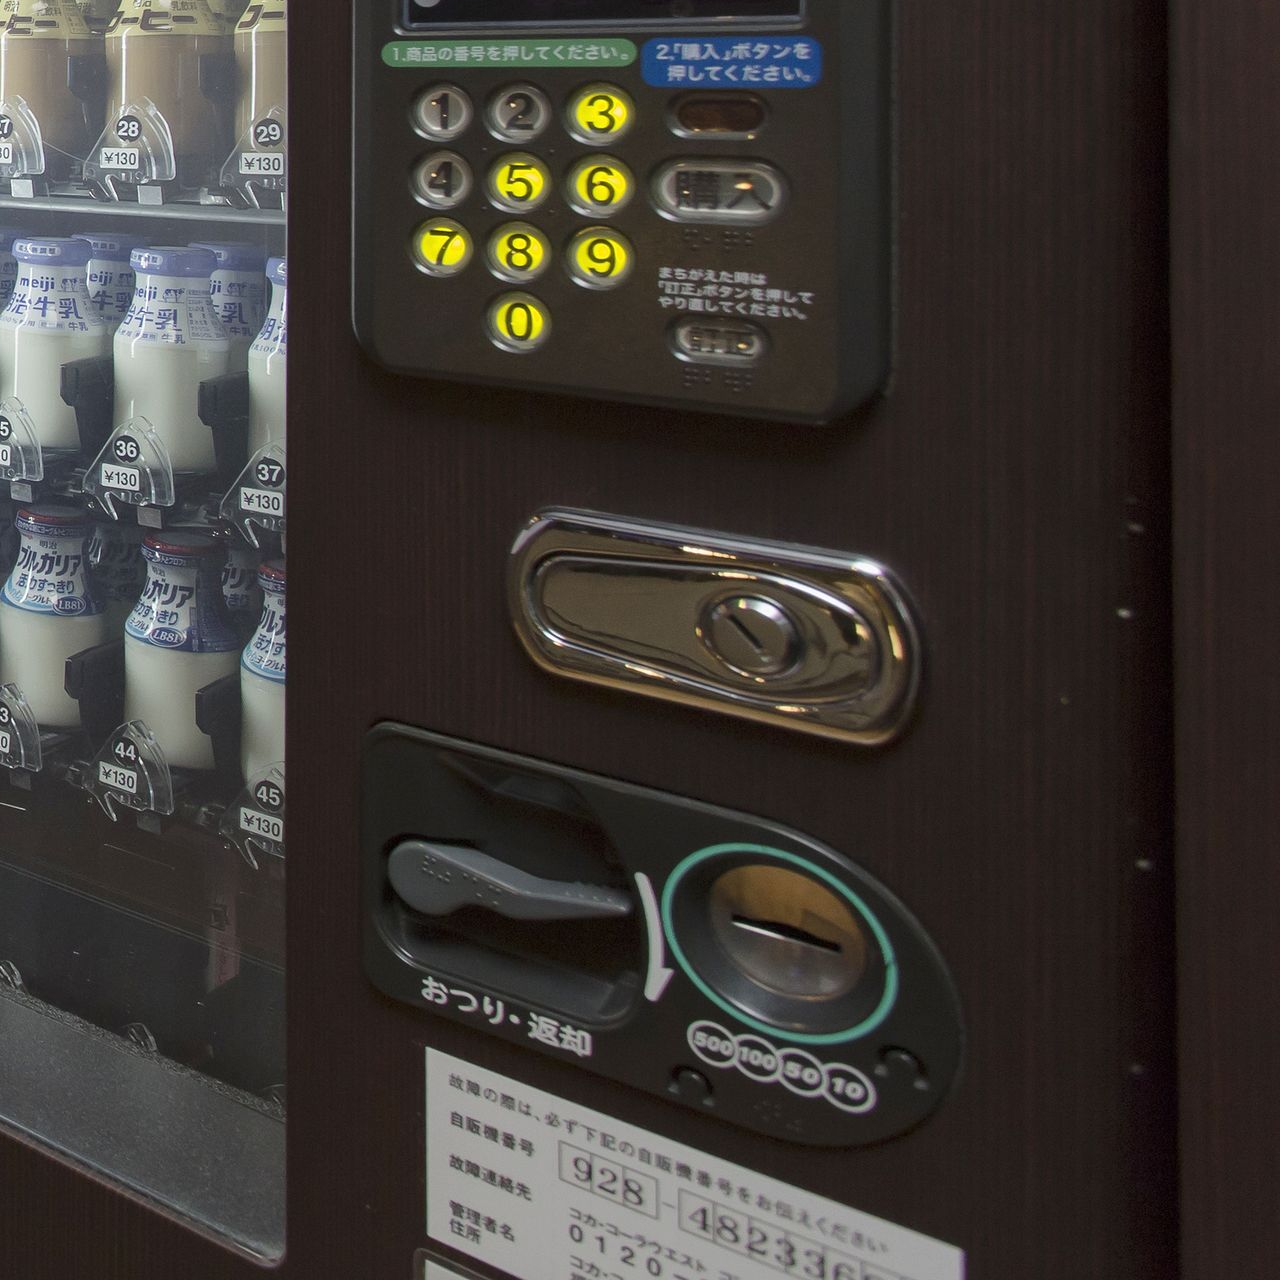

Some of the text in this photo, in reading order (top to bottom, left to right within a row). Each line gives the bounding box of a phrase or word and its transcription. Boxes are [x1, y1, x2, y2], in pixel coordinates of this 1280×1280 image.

[393, 45, 630, 63] 1.商品の番号を押してください。
[667, 64, 813, 82] 押してください。
[505, 98, 535, 132] 2
[585, 94, 616, 134] 3
[117, 121, 139, 137] 28
[256, 124, 281, 142] 29
[103, 149, 138, 166] ¥130
[245, 157, 281, 172] ¥130
[428, 161, 454, 199] 4
[506, 163, 535, 202] 5
[586, 166, 617, 207] 6
[676, 170, 772, 211] 購入
[429, 229, 456, 266] 7
[505, 233, 534, 273] 8
[586, 239, 618, 278] 9
[20, 276, 55, 291] meiji
[658, 267, 767, 286] まちがえた時は
[658, 297, 808, 320] やり直してください。
[505, 303, 534, 342] 0
[116, 440, 137, 458] 36
[105, 470, 138, 487] ¥130
[257, 464, 282, 482] 37
[244, 491, 281, 510] ¥130
[19, 545, 82, 578] ブルガリア
[60, 600, 83, 611] LB81
[154, 631, 180, 644] LB81
[115, 742, 137, 761] 44
[102, 767, 136, 790] ¥130
[256, 785, 281, 806] 45
[244, 812, 281, 838] ¥130
[421, 976, 593, 1058] おつり・返却
[693, 1030, 865, 1099] 500 100 50 10
[450, 1111, 644, 1207] 自販機番号 928
[449, 1154, 533, 1202] 故障連絡先
[449, 1199, 516, 1242] 管理者名
[450, 1218, 482, 1244] 住所
